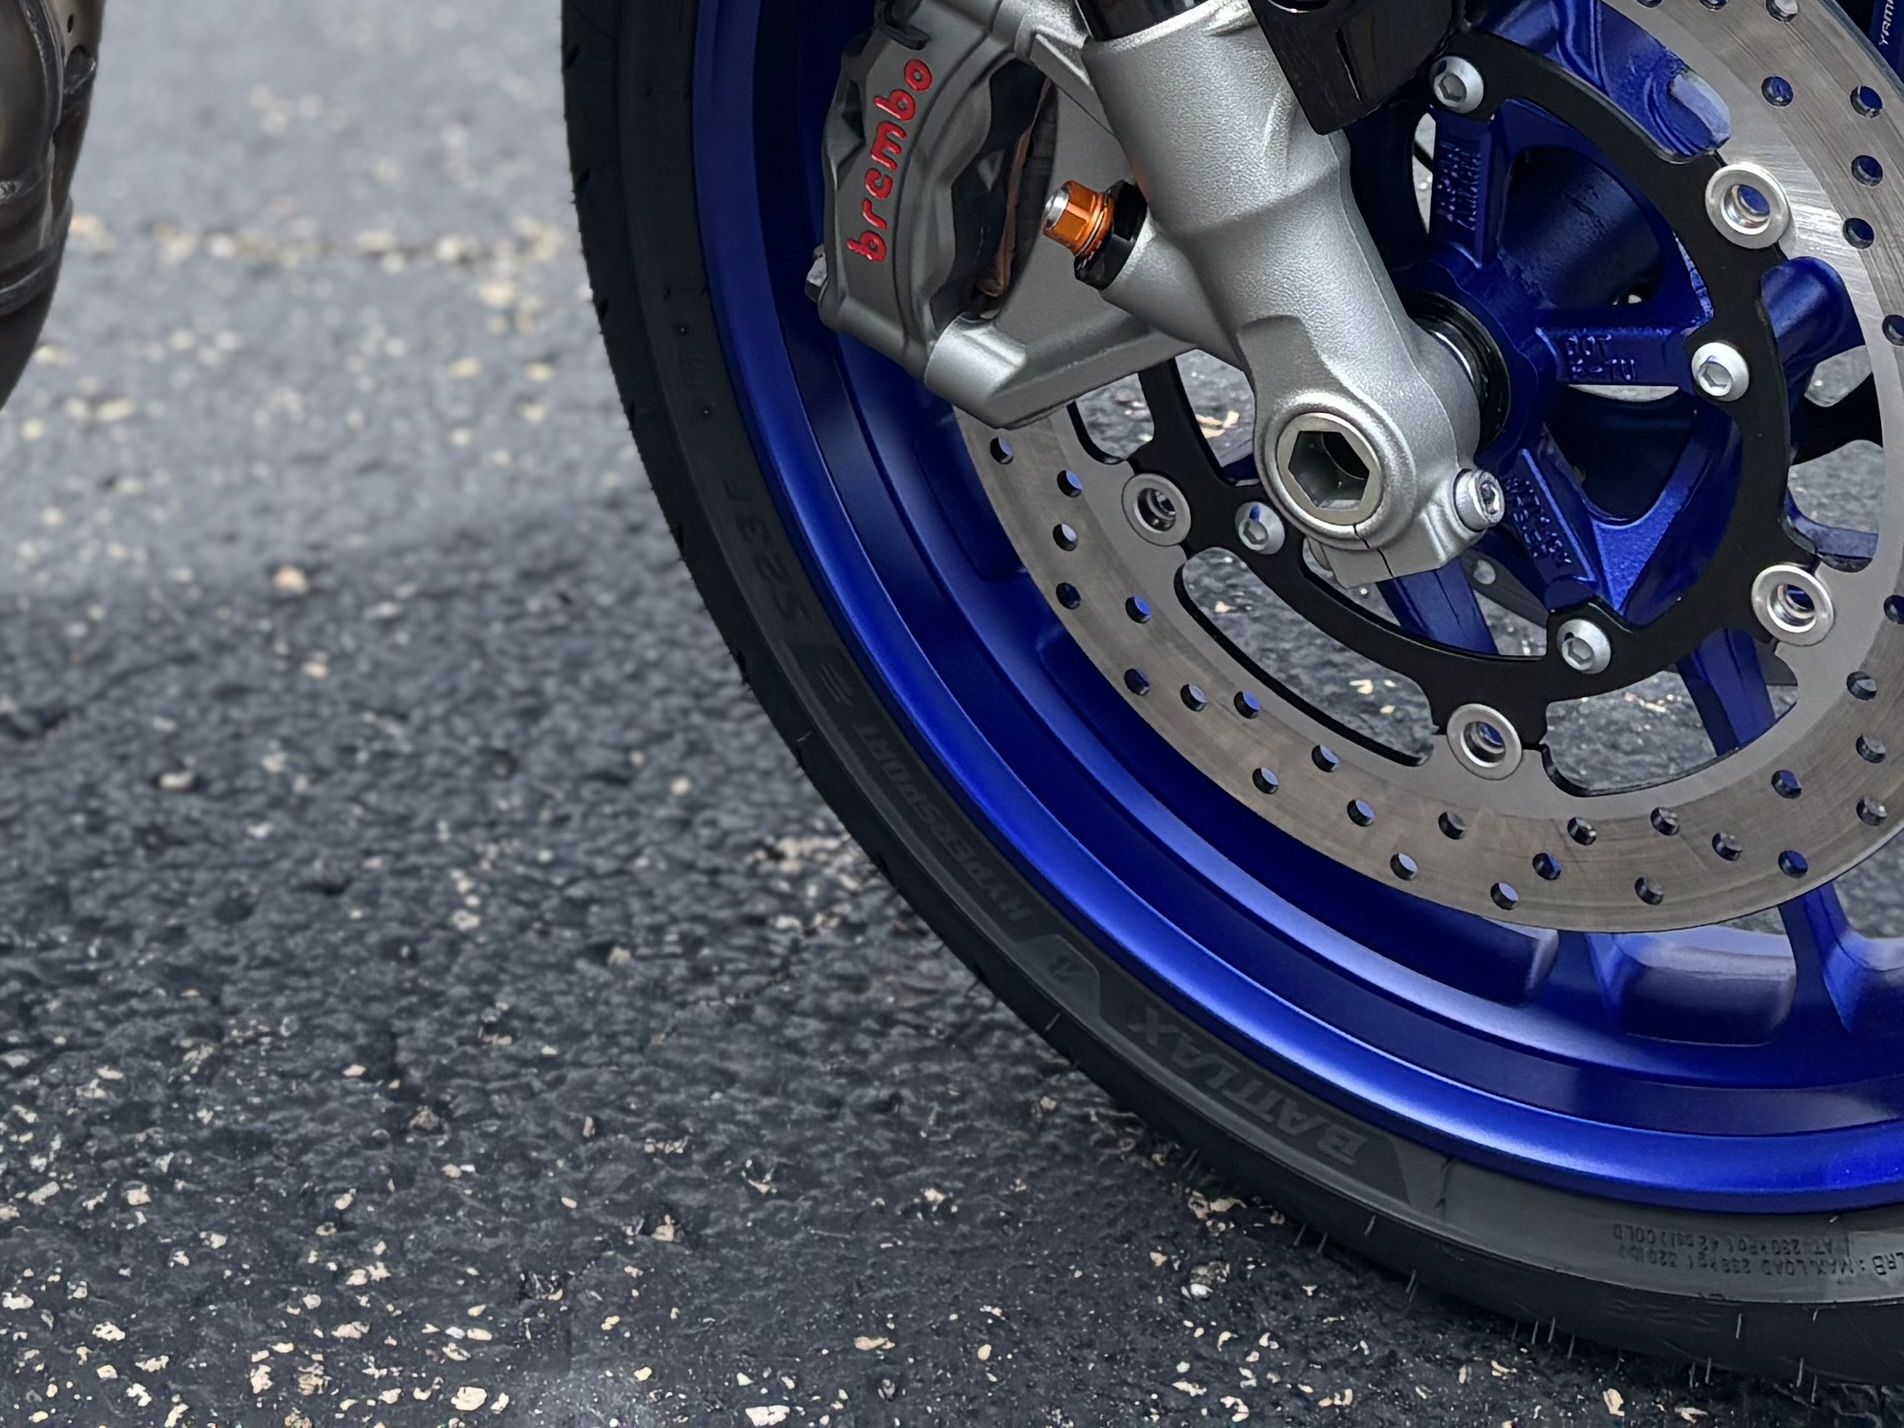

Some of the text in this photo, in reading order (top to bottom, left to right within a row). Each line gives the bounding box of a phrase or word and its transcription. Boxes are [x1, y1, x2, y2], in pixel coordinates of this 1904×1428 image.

[846, 58, 933, 263] brembo
[851, 723, 1032, 922] HYPERSPORT
[1126, 1006, 1369, 1166] BATTLAX
